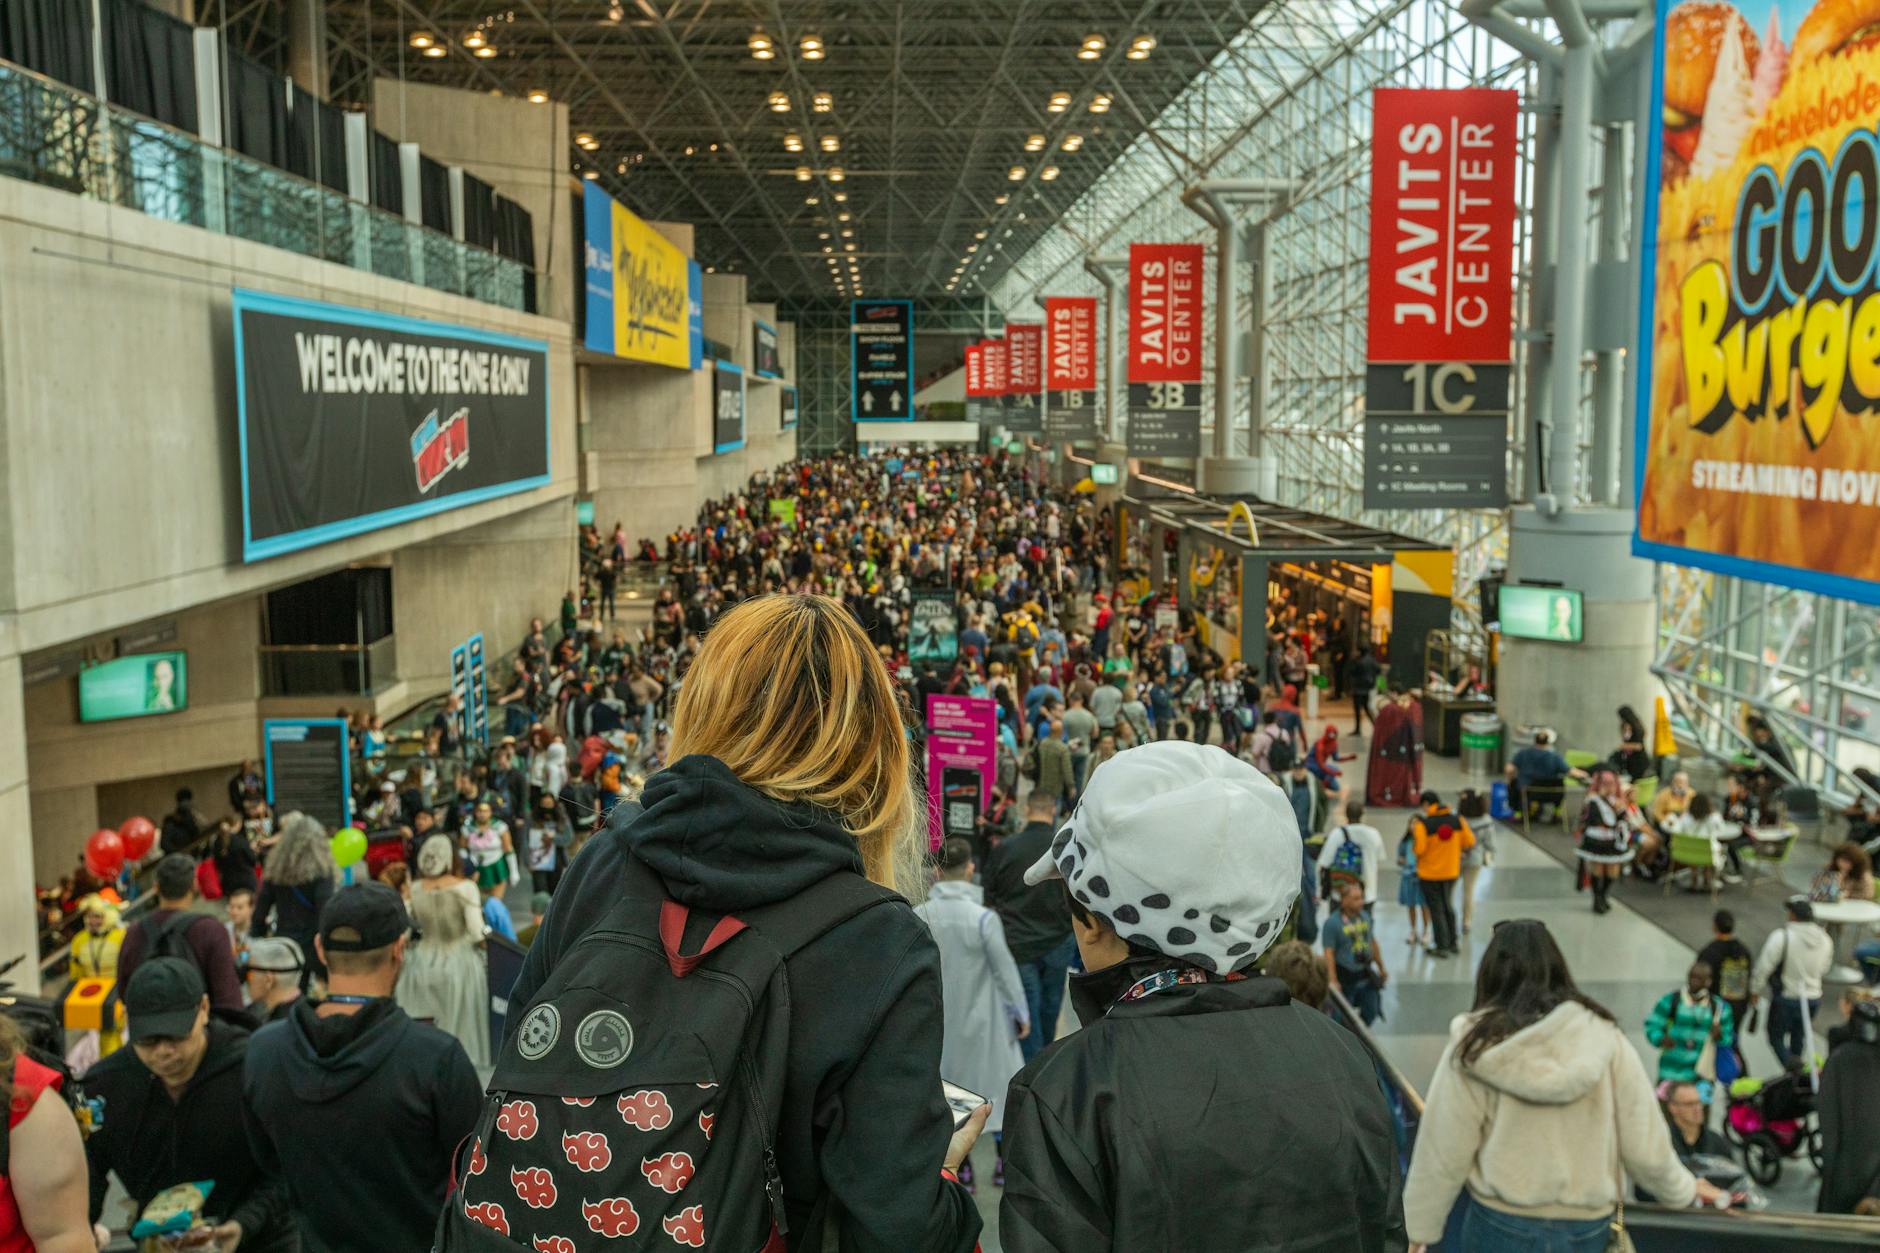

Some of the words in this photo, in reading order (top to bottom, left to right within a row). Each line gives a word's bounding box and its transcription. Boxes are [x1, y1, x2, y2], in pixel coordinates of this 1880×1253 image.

[1394, 122, 1443, 325] JAVITS
[1455, 122, 1495, 328] CENTER
[1733, 128, 1880, 314] GOO
[1054, 308, 1071, 378] JAVITS
[1076, 308, 1089, 379] CENTER
[1140, 261, 1165, 364] JAVITS
[1172, 260, 1192, 366] CENTER
[294, 331, 405, 394] WELCOME
[405, 344, 429, 395] TO
[429, 346, 460, 394] THE
[460, 349, 489, 394] ONE
[490, 352, 500, 395] &
[500, 355, 530, 396] ONLY
[1010, 332, 1024, 386] JAVITS
[1403, 362, 1477, 414] 1C
[1060, 389, 1084, 409] 1B
[1147, 382, 1185, 409] 3B
[1691, 459, 1817, 499] STREAMING
